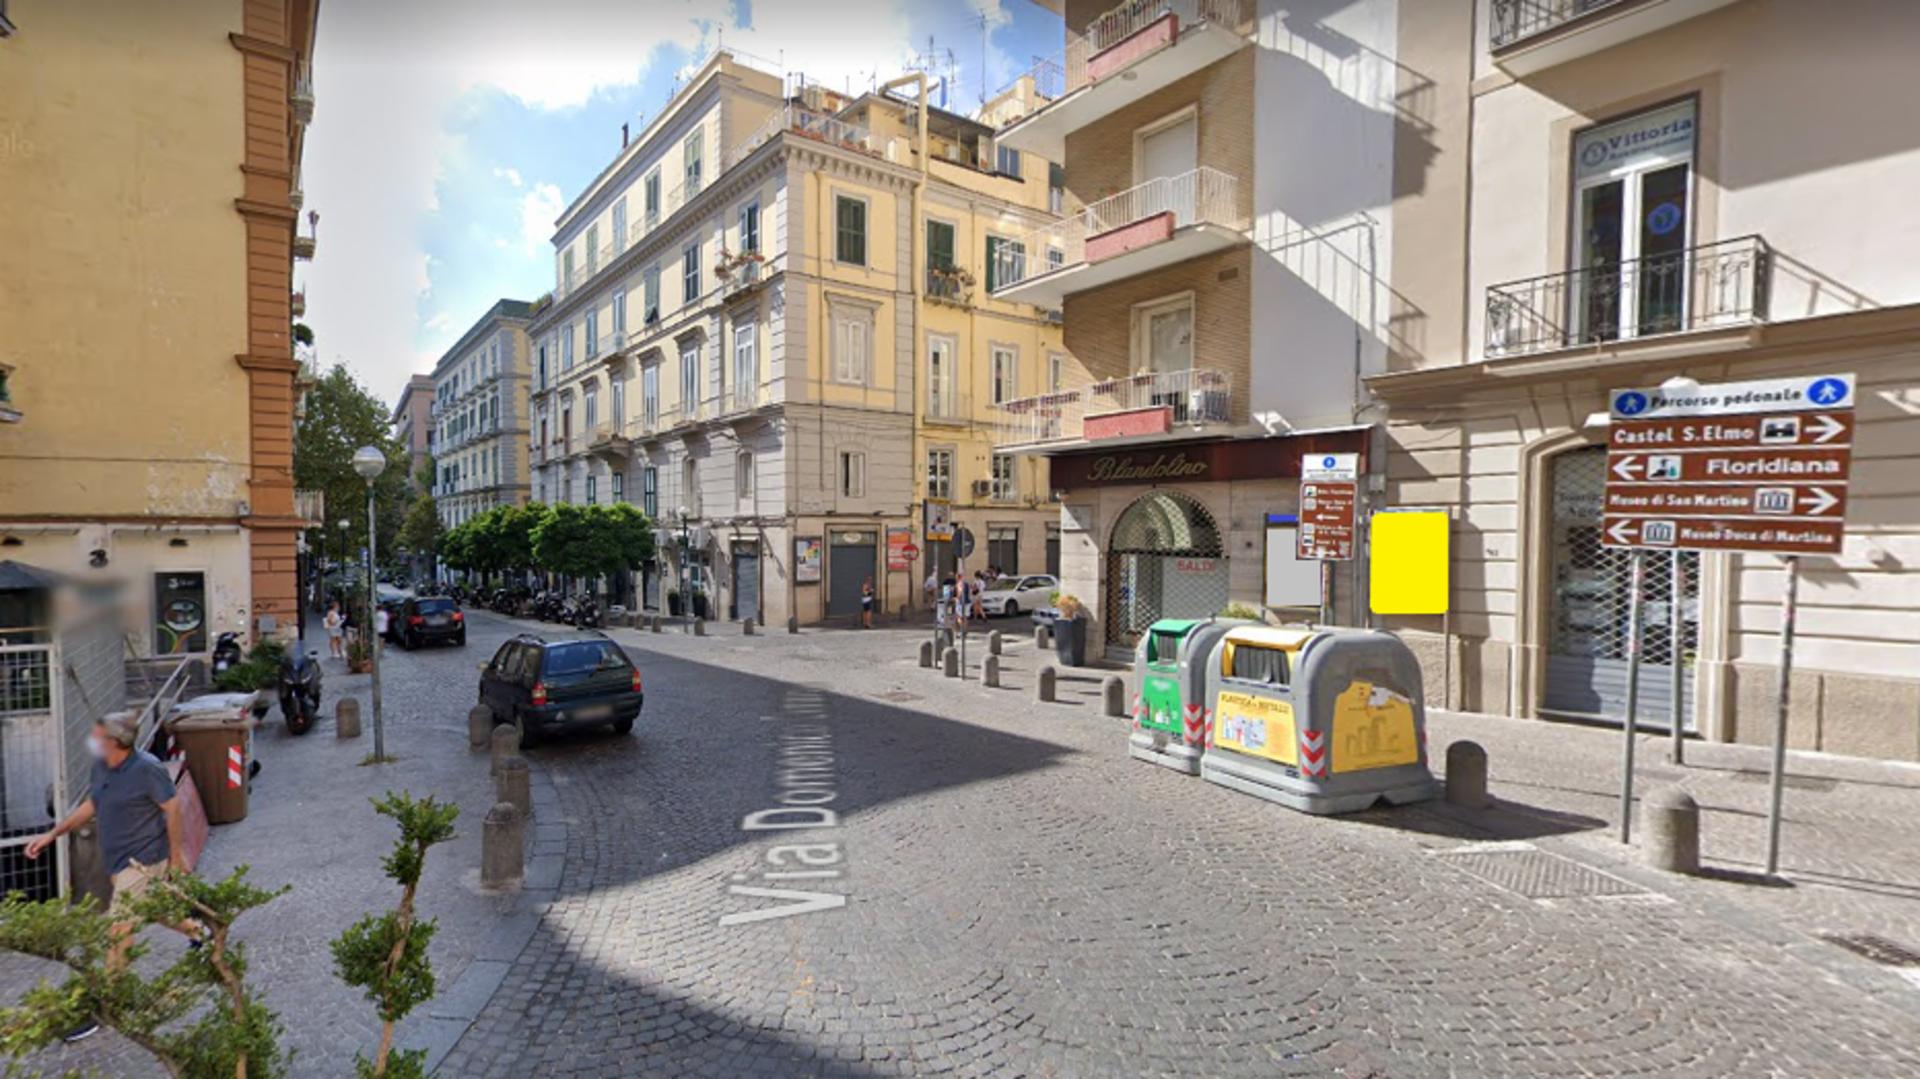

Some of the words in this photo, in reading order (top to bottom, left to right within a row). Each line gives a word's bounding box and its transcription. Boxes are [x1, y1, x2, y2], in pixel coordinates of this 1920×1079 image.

[1608, 118, 1692, 148] Vittoria
[1650, 395, 1719, 408] Percorso
[1724, 388, 1802, 407] pedonale
[1614, 427, 1674, 444] Castel
[1088, 453, 1208, 481] Blandolino
[1706, 457, 1840, 475] Floridiana
[1610, 494, 1649, 506] Museo
[1651, 494, 1664, 506] di
[1666, 494, 1692, 506] San
[1694, 494, 1749, 507] Martino
[1680, 528, 1720, 540] Museo
[1759, 530, 1775, 542] di
